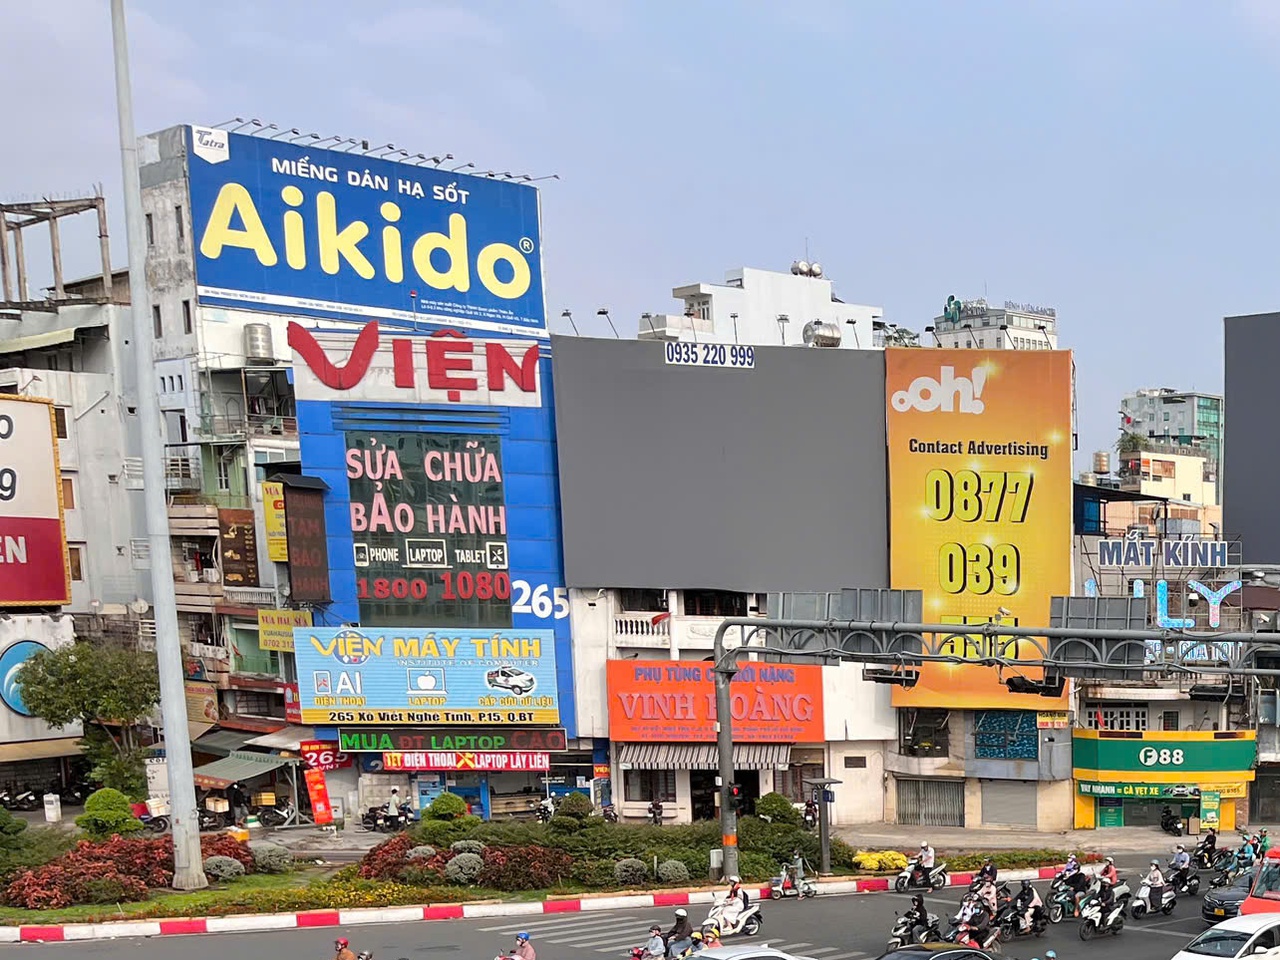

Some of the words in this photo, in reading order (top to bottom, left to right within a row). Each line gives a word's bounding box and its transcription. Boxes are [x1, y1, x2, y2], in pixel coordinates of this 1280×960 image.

[195, 129, 225, 149] Tatra
[271, 156, 338, 182] MIẾNG
[398, 178, 425, 200] HẠ
[433, 182, 470, 205] SỐT
[200, 182, 531, 299] Aikido
[287, 319, 540, 402] VIỆN
[666, 342, 699, 363] 0935
[702, 343, 726, 365] 220
[730, 345, 755, 367] 999
[908, 438, 964, 454] Contact
[967, 440, 1049, 460] Advertising
[346, 438, 403, 480] SỬA
[424, 440, 502, 483] CHỮA
[923, 468, 1035, 523] 0877
[350, 482, 415, 533] BẢO
[426, 494, 507, 535] HÀNH
[369, 548, 400, 562] PHONE
[409, 548, 444, 563] LAPTOP
[455, 550, 486, 563] TABLET
[1097, 530, 1156, 567] MẮT
[1162, 534, 1228, 568] KÍNH
[938, 541, 1021, 596] 039
[357, 578, 428, 599] 1800
[440, 571, 511, 600] 1080
[511, 580, 570, 619] 265
[310, 631, 385, 662] VIỆN
[392, 632, 460, 659] MÁY
[470, 632, 542, 658] TÍNH
[397, 659, 455, 667] INSTITUTE
[460, 659, 475, 667] OF
[478, 659, 540, 667] COMPUTER
[634, 667, 662, 684] PHỤ
[665, 664, 700, 681] TÙNG
[760, 666, 795, 685] NẶNG
[313, 696, 338, 707] ĐIỆN
[340, 696, 366, 707] THOẠI
[408, 697, 447, 706] LAPTOP
[534, 695, 553, 708] LIỆU
[616, 693, 696, 720] VINH
[329, 711, 355, 722] 265
[478, 712, 503, 723] P.15,
[507, 711, 534, 722] Q.BT
[340, 733, 394, 750] MUA
[399, 735, 425, 750] ĐT
[431, 735, 506, 750] LAPTOP
[510, 731, 564, 749] CAO
[305, 750, 349, 767] 265
[404, 752, 427, 771] ĐIỆN
[428, 753, 456, 770] THOẠI
[474, 753, 508, 769] LAPTOP
[510, 752, 528, 769] LẤY
[530, 752, 549, 769] LIỀN
[1139, 747, 1184, 766] F88
[1123, 784, 1134, 796] CÀ
[1149, 786, 1159, 796] XE
